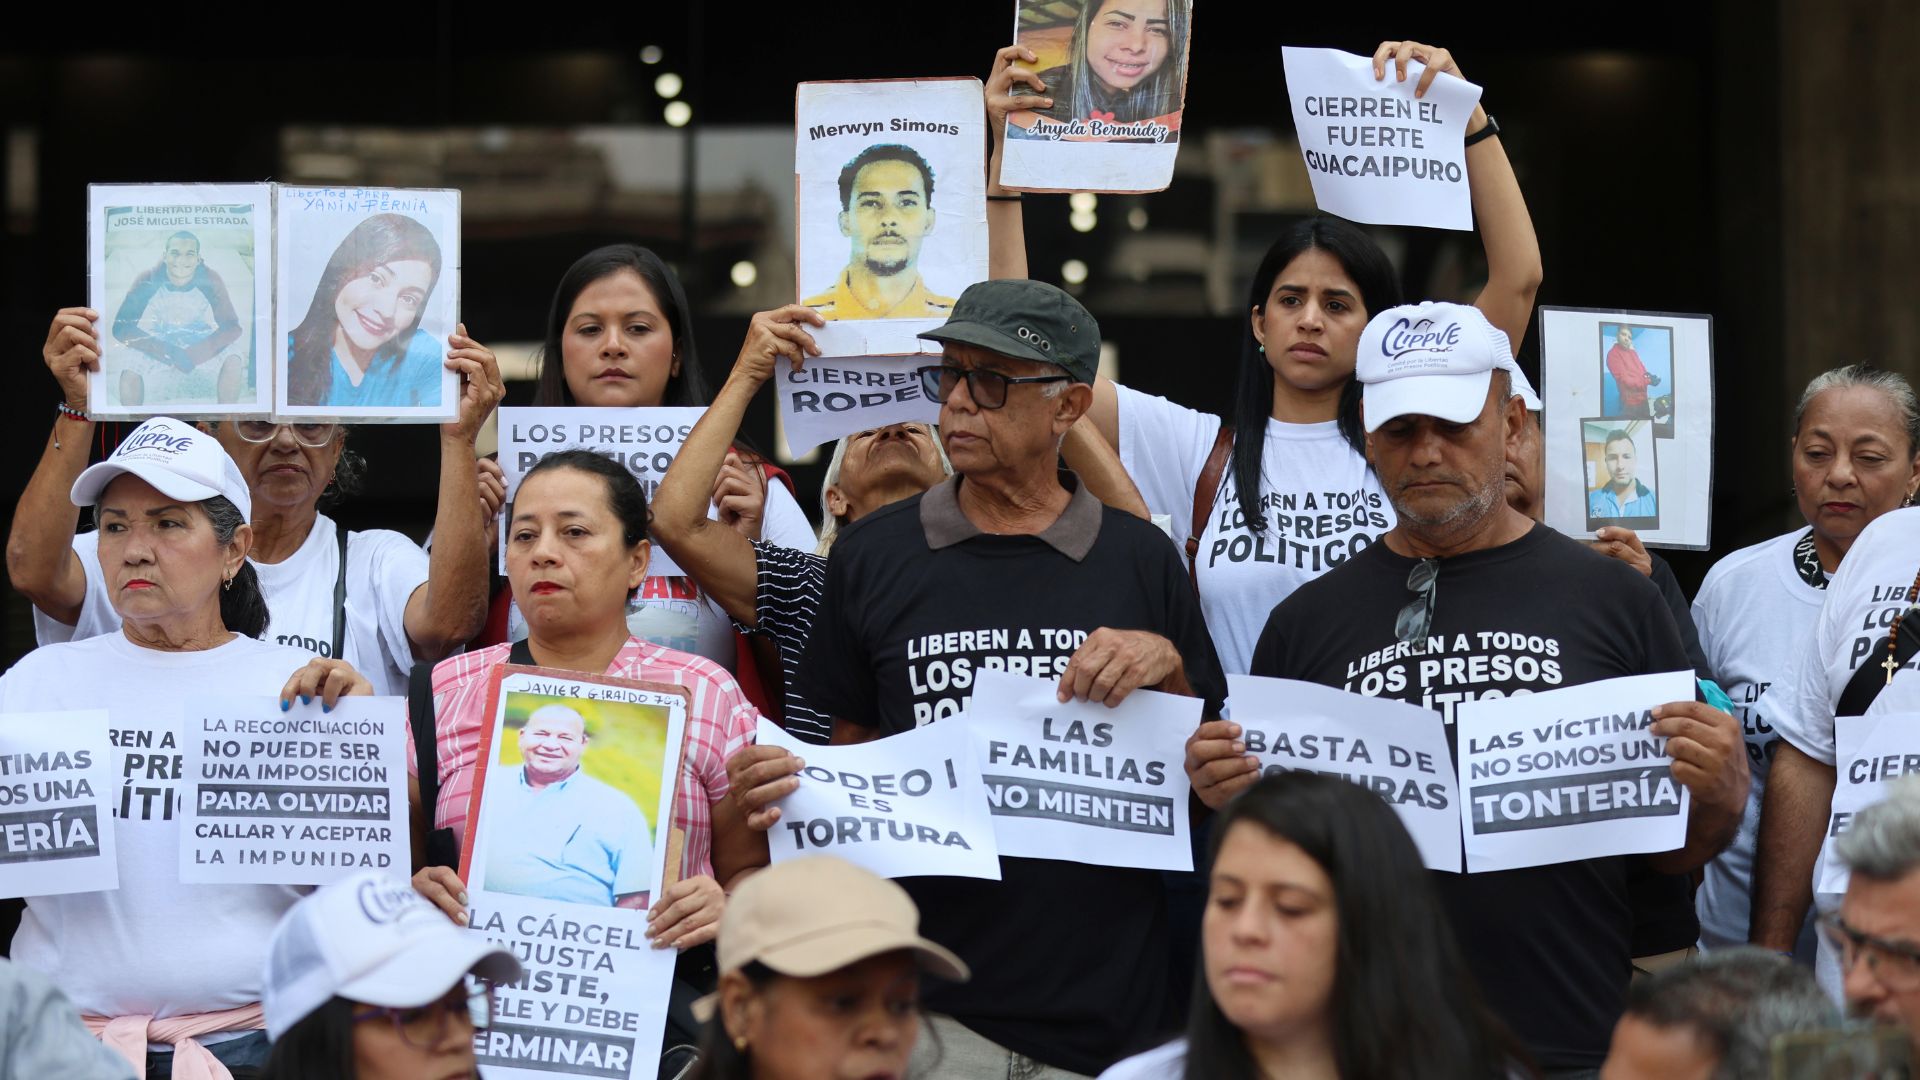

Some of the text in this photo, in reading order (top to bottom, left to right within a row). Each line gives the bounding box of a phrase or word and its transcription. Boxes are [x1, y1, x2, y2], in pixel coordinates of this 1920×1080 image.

[1305, 96, 1443, 124] CIERREN EL
[809, 118, 959, 140] Merwyn Simons
[1028, 119, 1168, 142] Anyela Bermúdez
[1327, 126, 1424, 149] FUERTE
[1305, 150, 1462, 183] GUACAIPURO
[114, 216, 249, 227] JOSÉ MIGUEL ESTRADA
[136, 206, 226, 214] LIBERTAD PARA
[792, 384, 921, 413] RODE
[512, 424, 691, 444] LOS PRESOS
[1304, 492, 1318, 511] A
[1278, 505, 1389, 539] PRESOS
[1209, 533, 1384, 572] POLÍTICO
[276, 634, 332, 658] TODO
[907, 629, 1088, 660] LIBEREN A TOD
[1453, 634, 1471, 652] A
[1477, 631, 1561, 657] TODOS
[908, 655, 1070, 696] LOS PRES
[1419, 654, 1563, 688] PRESOS
[519, 681, 581, 698] JAVIER
[160, 731, 176, 749] A
[203, 718, 384, 736] LA RECONCILIACIÓN
[1043, 717, 1114, 748] LAS
[1469, 709, 1657, 755] LAS VÍCTIMA
[203, 740, 380, 760] NO PUEDE SER
[989, 740, 1166, 786] FAMILIAS
[1244, 729, 1436, 774] BASTA DE
[1471, 757, 1511, 780] NO
[1517, 743, 1616, 774] SOMOS
[123, 753, 182, 780] PRE
[202, 762, 387, 783] UNA IMPOSICIÓN
[795, 758, 958, 797] ODEO I
[34, 778, 95, 803] UNA
[200, 790, 387, 814] PARA OLVIDAR
[849, 793, 893, 813] ES
[1474, 770, 1679, 824] TONTERÍA
[984, 783, 1169, 828] NO MIENTEN
[195, 823, 392, 842] CALLAR Y ACEPTAR
[786, 816, 972, 850] TORTURA
[195, 849, 391, 868] LA IMPUNIDAD
[468, 909, 641, 951] LA CÁRCEL
[493, 997, 640, 1032] ELE Y DEBE
[472, 1030, 629, 1072] ERMINAR
